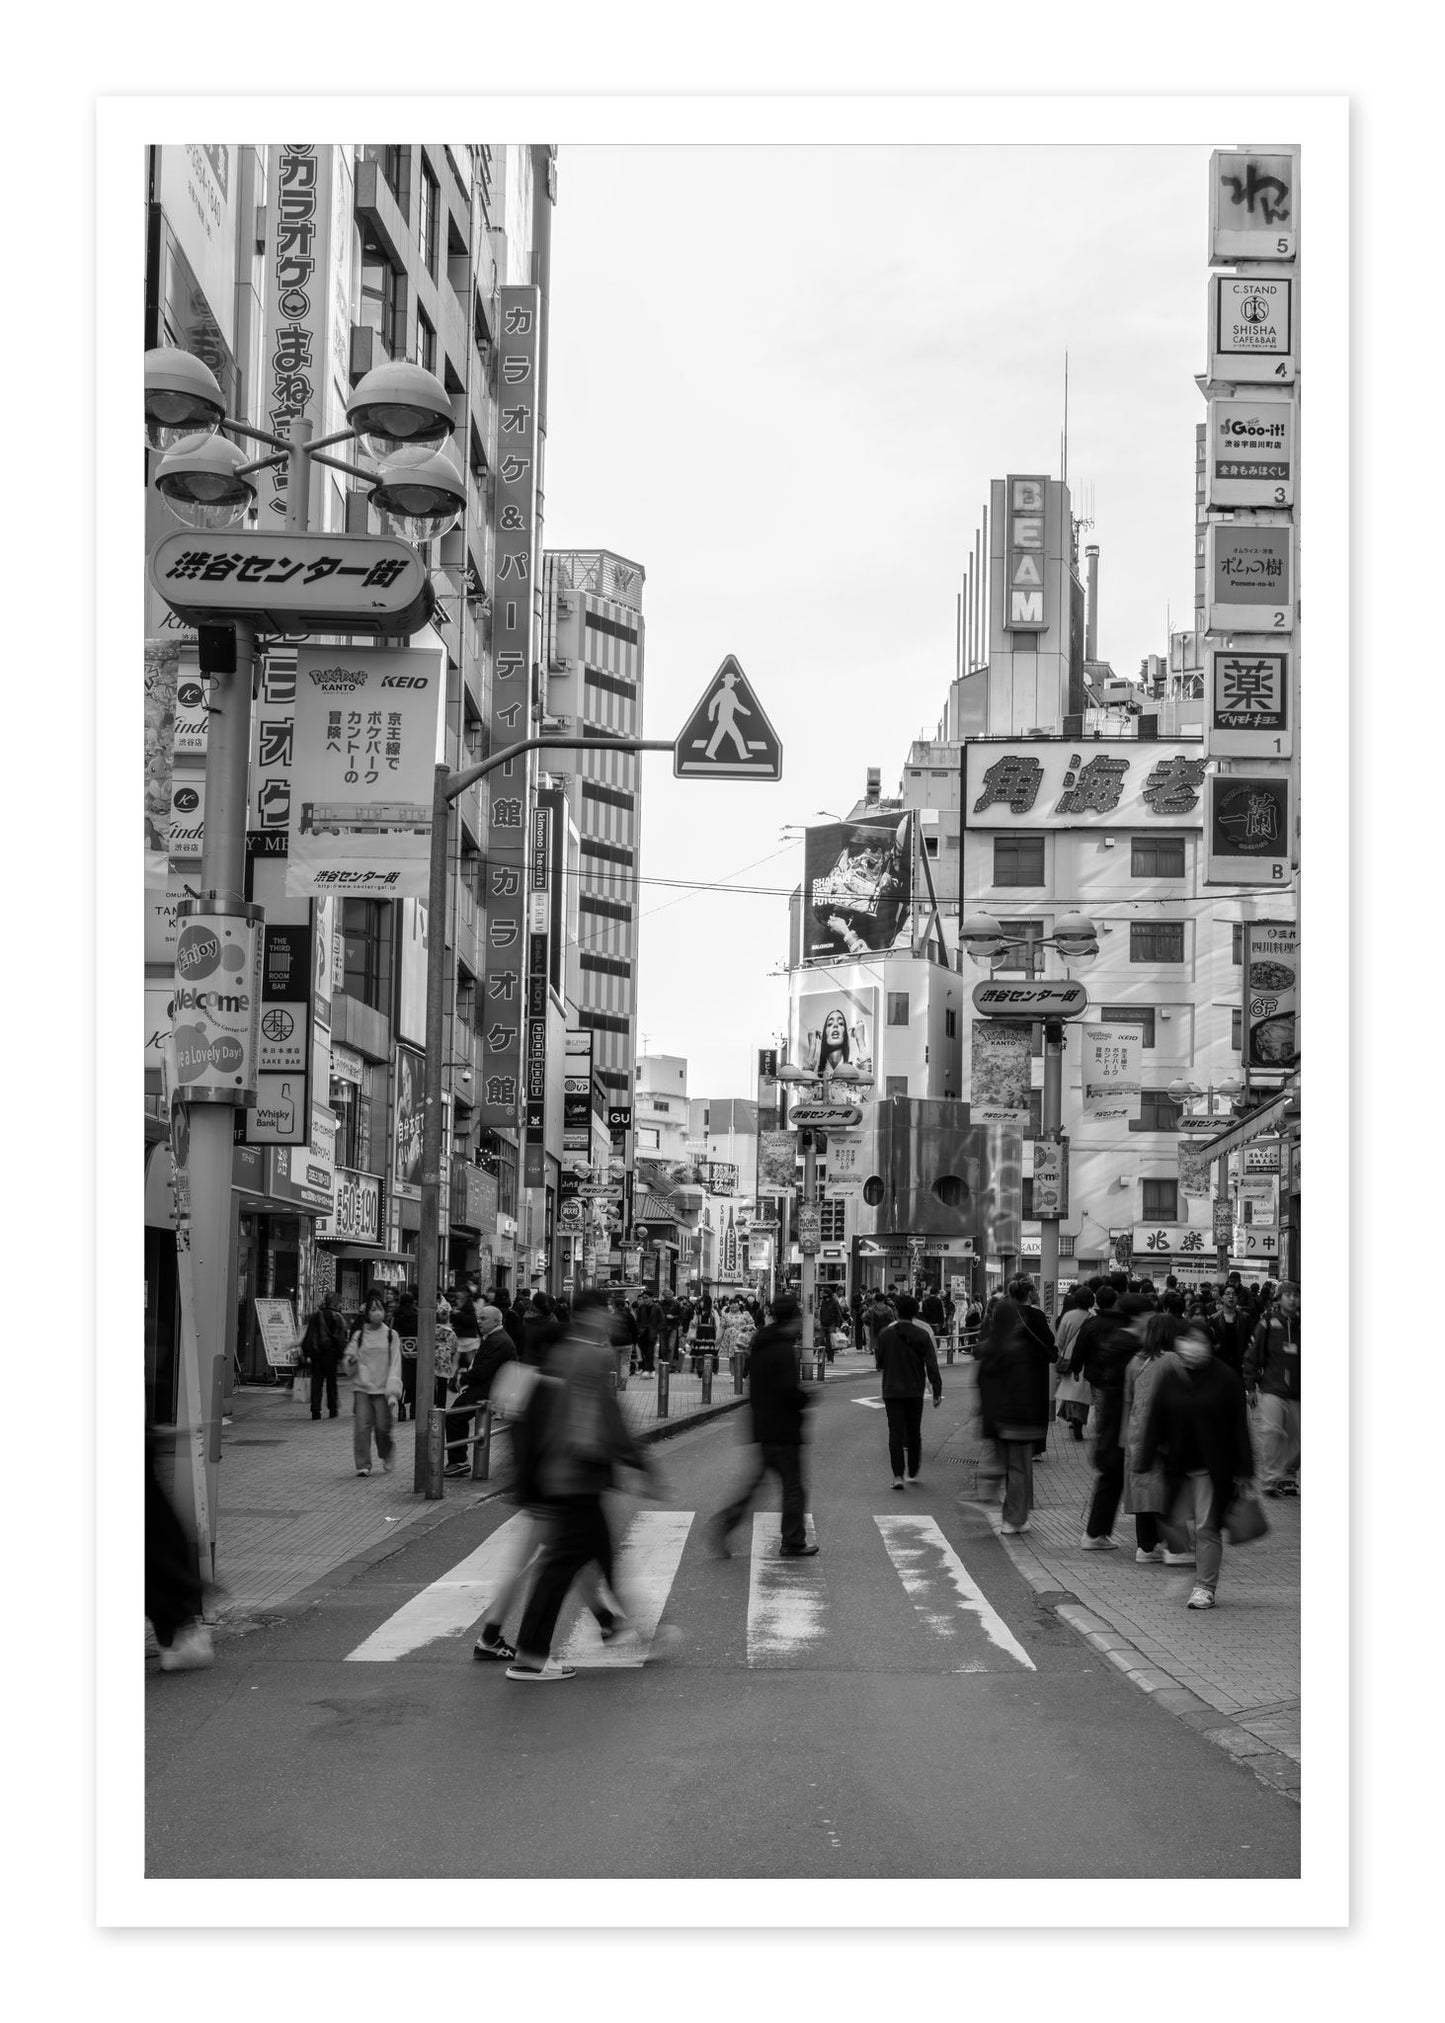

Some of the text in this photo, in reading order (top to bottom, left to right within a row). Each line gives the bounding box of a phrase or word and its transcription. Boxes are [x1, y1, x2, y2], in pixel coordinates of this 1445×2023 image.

[278, 156, 317, 289] カラオケ
[1276, 238, 1289, 254] 5
[1233, 285, 1277, 294] C.STAND
[1233, 325, 1277, 335] SHISHA
[1275, 363, 1287, 377] 4
[1224, 440, 1282, 449] 渋谷宇田川町店
[1220, 464, 1286, 475] 全身もみほぐし
[1274, 487, 1286, 504] 3
[1013, 480, 1042, 622] BEAM
[165, 550, 410, 589] 渋谷センター街
[1220, 556, 1283, 576] ポムの樹
[1230, 580, 1275, 588] Pomme-no-ki
[1273, 612, 1285, 628] 2
[321, 684, 356, 692] KANTO
[380, 676, 429, 689] KEIO
[1223, 659, 1274, 710] 薬
[326, 710, 343, 753] 冒険へ
[178, 738, 203, 747] 渋谷店
[343, 710, 362, 784] カントーの
[363, 710, 382, 785] ポケパーク
[385, 711, 403, 771] 京王線で
[1273, 738, 1282, 753] 1
[972, 754, 1206, 814] 角海老
[174, 844, 199, 852] 渋谷店
[534, 812, 545, 887] kimono hearts
[314, 870, 402, 884] 渋谷センター街
[1271, 864, 1284, 879] B
[269, 944, 291, 952] THIRD
[272, 937, 287, 945] THE
[1251, 942, 1294, 954] 四川料理
[178, 938, 218, 973] Enjoy
[268, 972, 290, 980] ROOM
[272, 982, 287, 990] BAR
[174, 987, 249, 1013] Welcome
[980, 989, 1079, 1003] 渋谷センター街
[1249, 998, 1279, 1018] 6F
[191, 1044, 221, 1063] Lovely
[223, 1046, 242, 1058] Day!
[257, 1109, 290, 1121] Whisky
[610, 1112, 630, 1124] GU
[792, 1109, 854, 1120] 渋谷センター街
[256, 1118, 276, 1128] Bank
[726, 1229, 735, 1270] BEER
